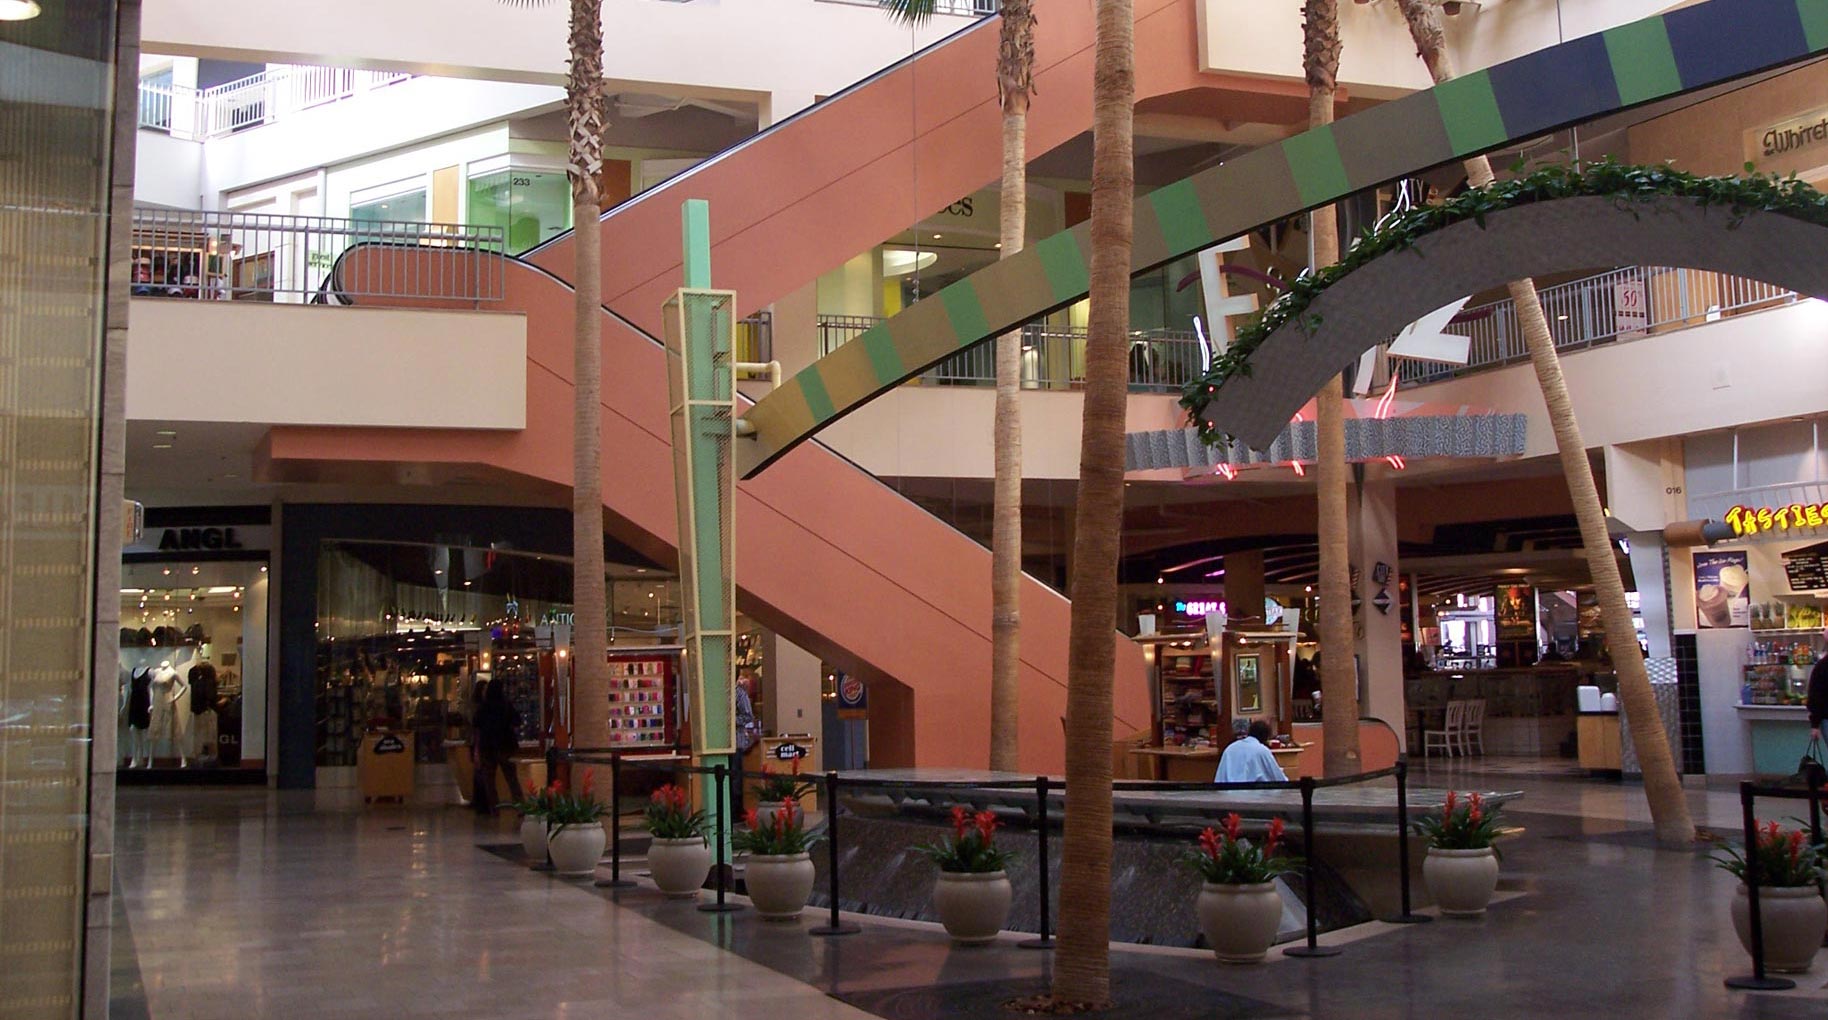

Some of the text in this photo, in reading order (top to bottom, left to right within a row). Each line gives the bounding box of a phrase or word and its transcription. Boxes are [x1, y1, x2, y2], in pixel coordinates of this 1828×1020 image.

[513, 178, 531, 186] 233
[1665, 486, 1682, 495] 016
[158, 528, 242, 550] ANGL
[780, 744, 794, 752] cell
